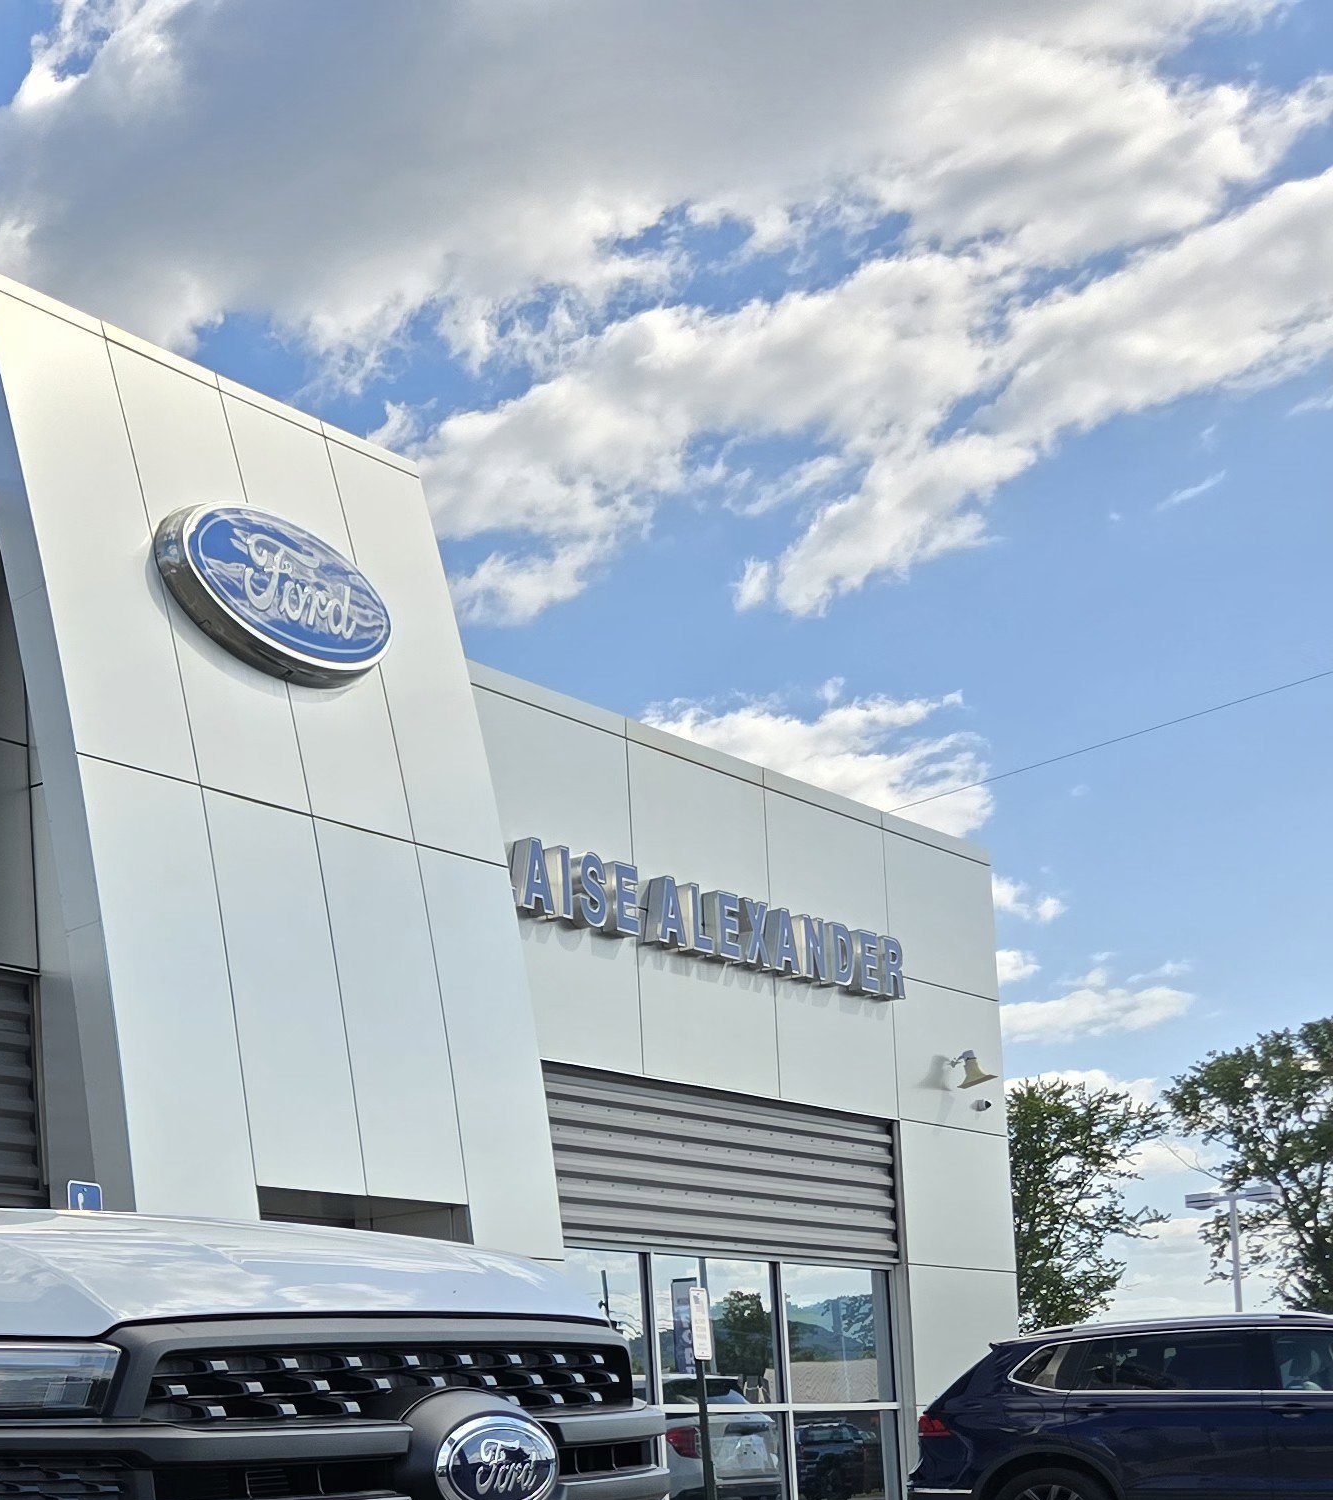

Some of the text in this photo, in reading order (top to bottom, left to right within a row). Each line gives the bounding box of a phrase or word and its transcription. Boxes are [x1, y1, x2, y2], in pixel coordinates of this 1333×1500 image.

[243, 533, 357, 640] Ford
[513, 837, 907, 1001] AISE ALEXANDER
[475, 1438, 537, 1495] Ford
